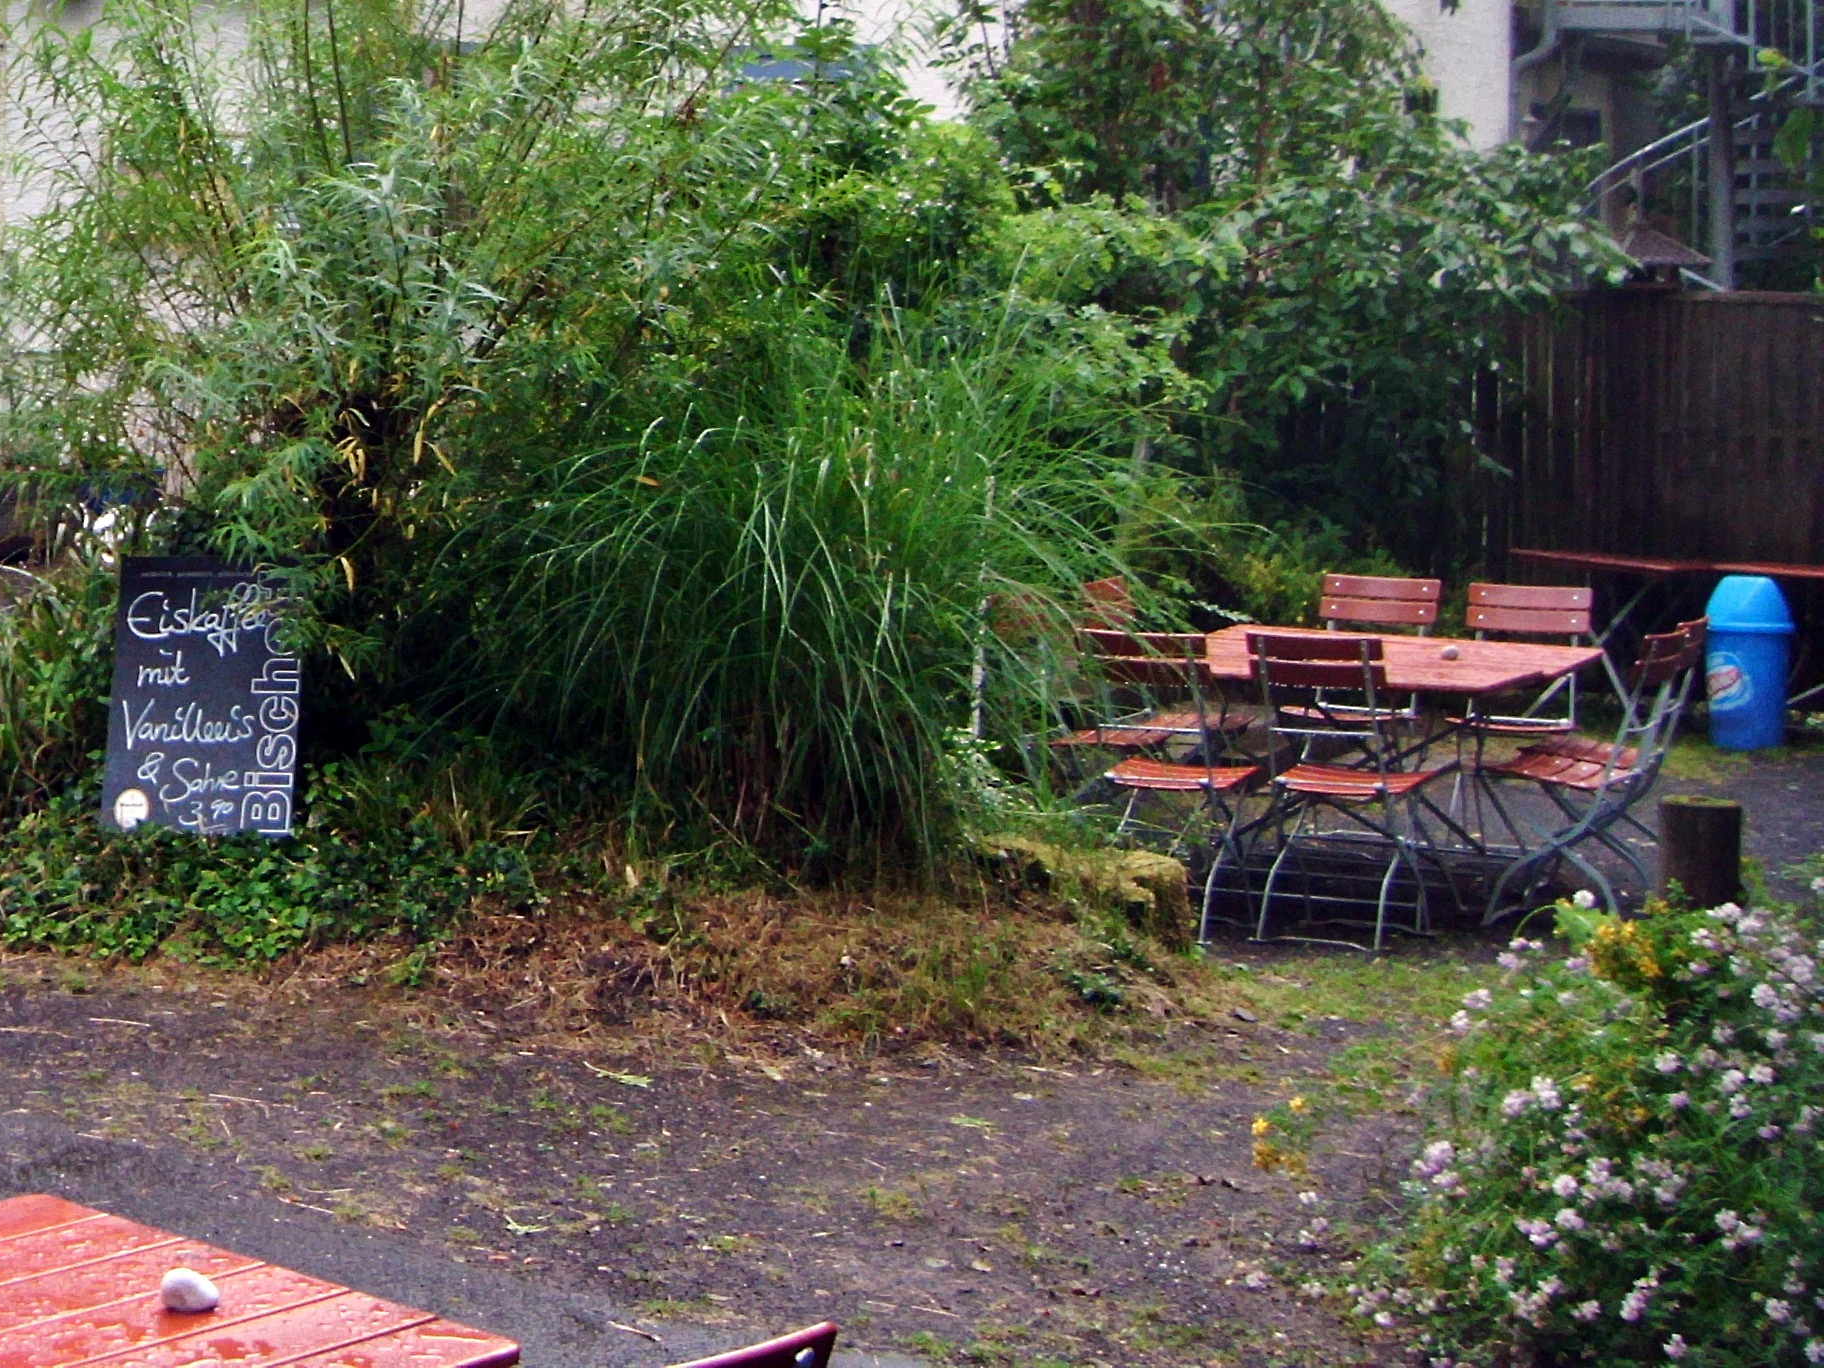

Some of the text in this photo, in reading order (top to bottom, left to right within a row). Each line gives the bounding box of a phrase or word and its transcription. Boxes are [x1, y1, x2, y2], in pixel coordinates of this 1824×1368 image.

[127, 581, 273, 658] Eiskaffee
[137, 649, 190, 687] mit
[122, 698, 255, 750] Vanilleeis
[239, 570, 304, 834] Bischo
[137, 752, 240, 803] & Sahne
